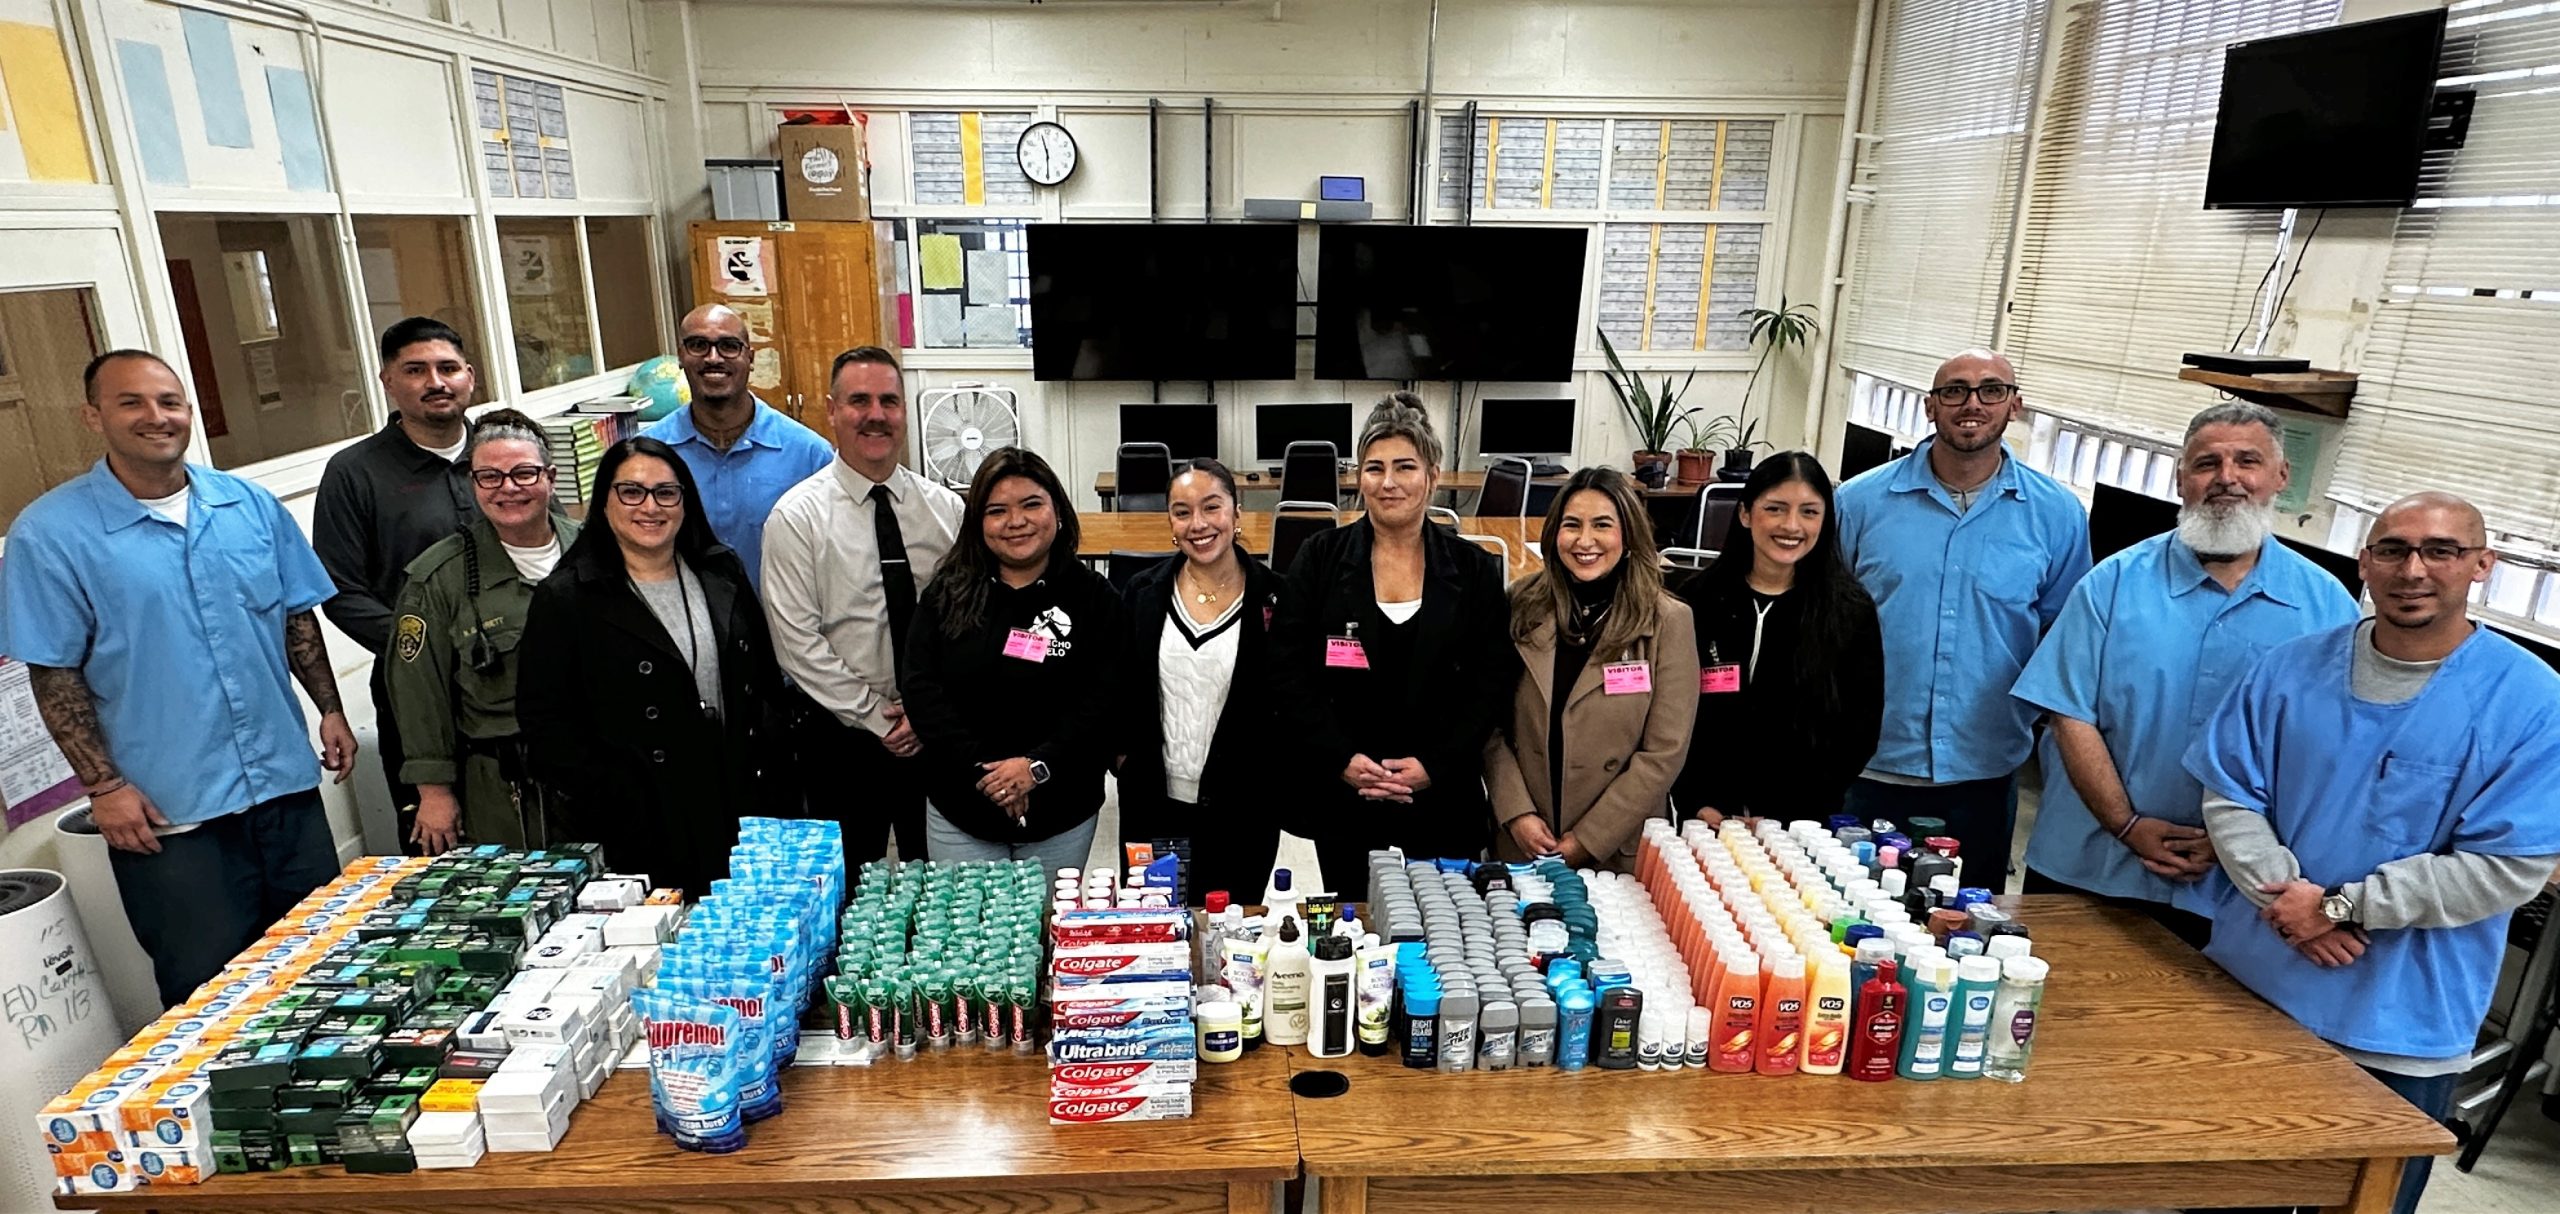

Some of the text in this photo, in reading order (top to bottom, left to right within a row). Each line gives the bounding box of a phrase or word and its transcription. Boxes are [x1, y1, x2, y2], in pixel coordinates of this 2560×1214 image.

[1607, 665, 1643, 674] VISITOR
[1703, 667, 1734, 675] VISITOR
[1059, 957, 1122, 971] Colgate
[1272, 971, 1305, 979] Aveeno
[3, 984, 37, 1022] ED
[65, 988, 91, 1025] 113
[1731, 1000, 1753, 1008] VO5
[1780, 1002, 1800, 1011] VO5
[1821, 1000, 1842, 1009] VO5
[930, 1001, 941, 1037] Colgate
[956, 996, 968, 1032] Colgate
[989, 1003, 999, 1038] Colgate
[1068, 1015, 1125, 1026] Colgate
[870, 1007, 881, 1042] Colgate
[1014, 1005, 1024, 1042] Colgate
[1060, 1066, 1135, 1080] Colgate
[1055, 1087, 1121, 1097] Colgate
[1054, 1101, 1130, 1117] Colgate
